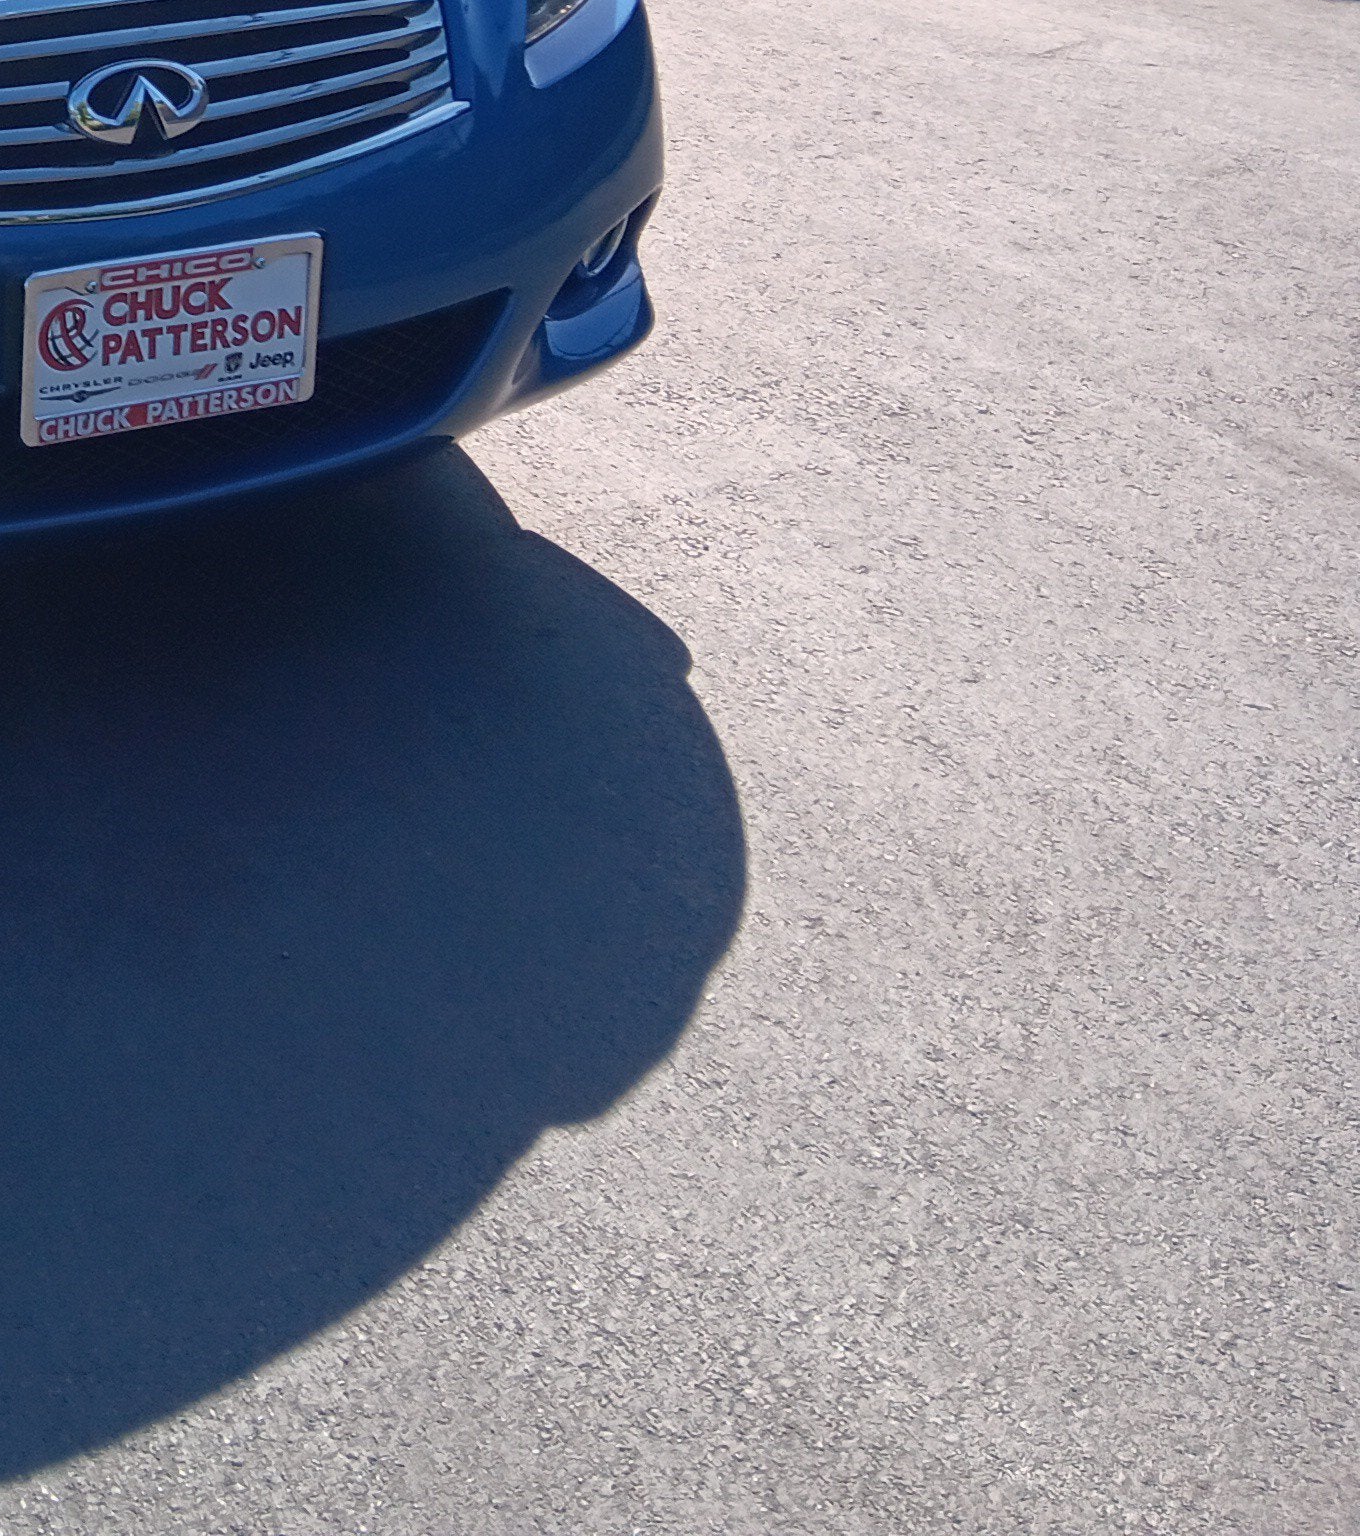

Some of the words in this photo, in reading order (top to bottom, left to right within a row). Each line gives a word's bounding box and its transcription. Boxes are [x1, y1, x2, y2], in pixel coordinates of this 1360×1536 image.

[101, 252, 252, 287] CHICO
[103, 277, 234, 327] CHUCK
[101, 305, 302, 366] PATTERSON
[248, 351, 294, 369] Jeep
[39, 376, 123, 394] CHRYSLER
[38, 407, 132, 443] CHUCK
[146, 379, 299, 424] PATTERSON
